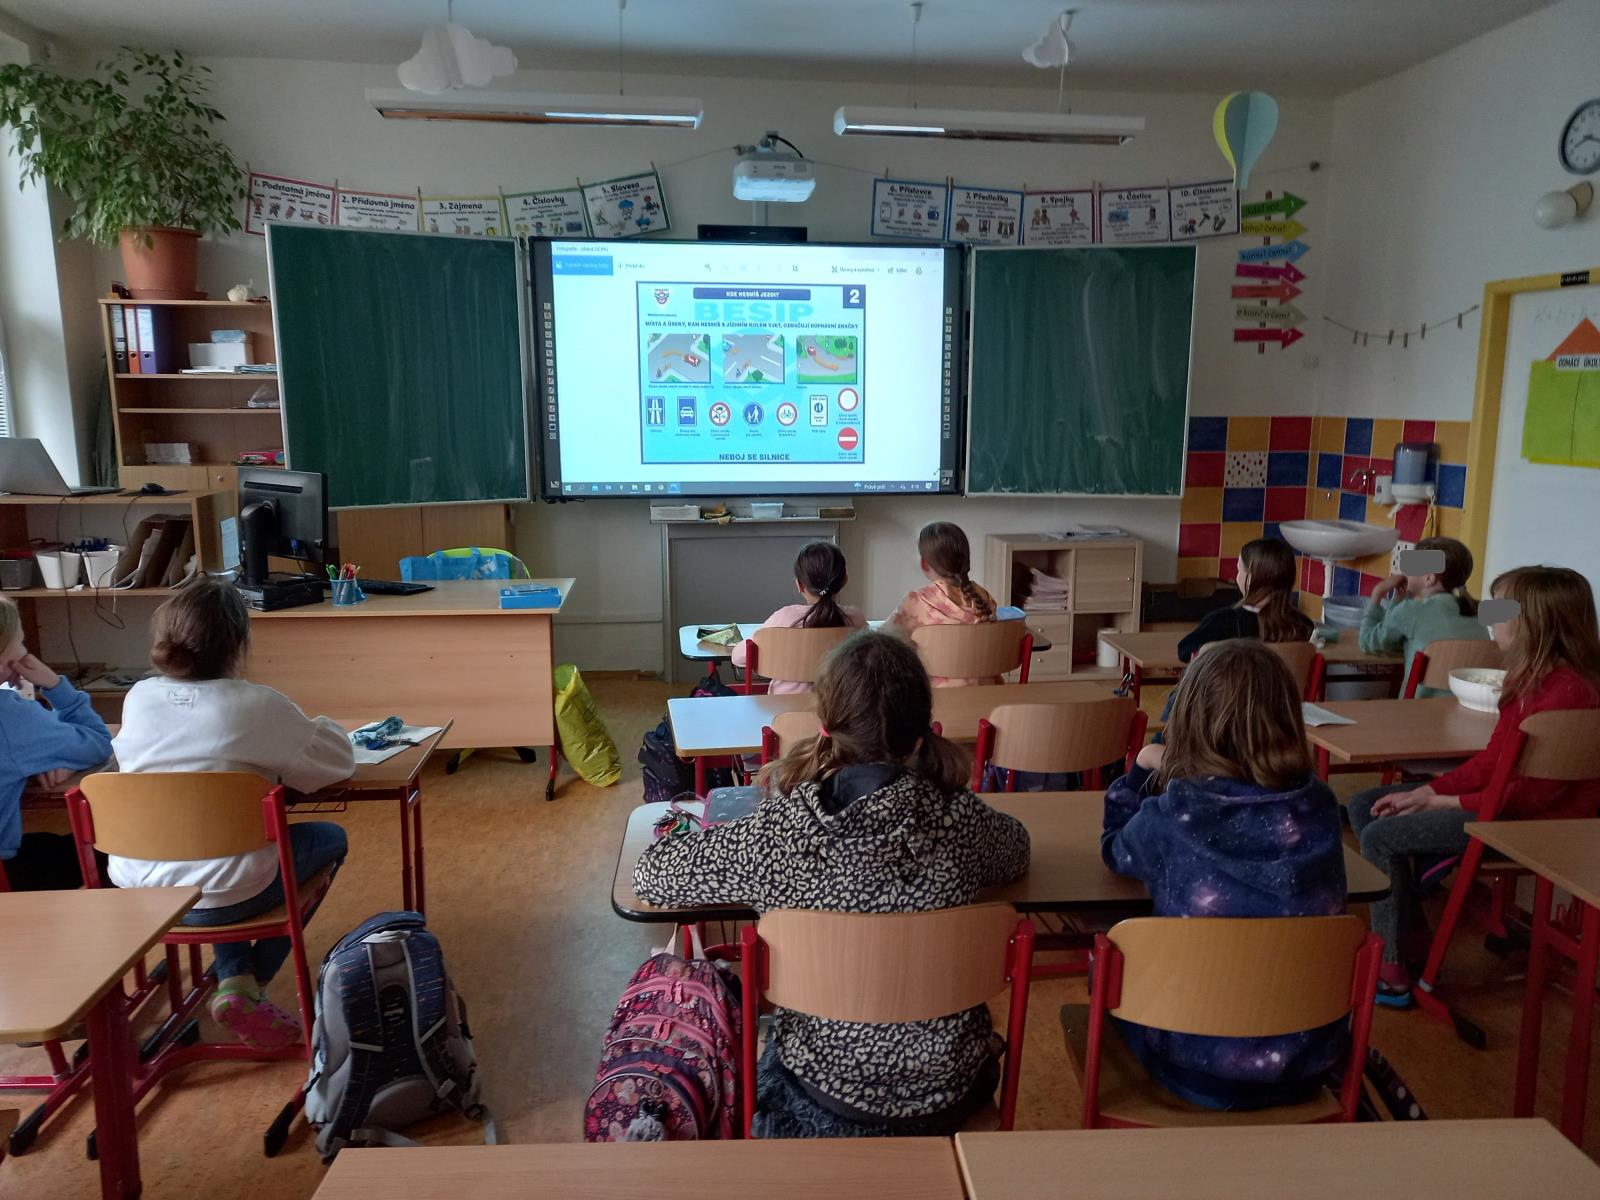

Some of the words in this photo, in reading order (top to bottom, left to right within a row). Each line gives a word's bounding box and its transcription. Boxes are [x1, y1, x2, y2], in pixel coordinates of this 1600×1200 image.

[262, 180, 304, 196] Podstatná
[304, 187, 332, 200] jména
[610, 181, 640, 193] Slovesa
[352, 195, 390, 208] Přídavná
[390, 199, 416, 211] jména
[449, 201, 483, 212] Zájmena
[849, 289, 861, 304] 2
[694, 302, 814, 322] BESIP
[1558, 356, 1580, 368] DOMÁCÍ
[718, 453, 746, 462] NEBOJ
[747, 453, 758, 462] SE
[759, 453, 790, 461] SILNICE
